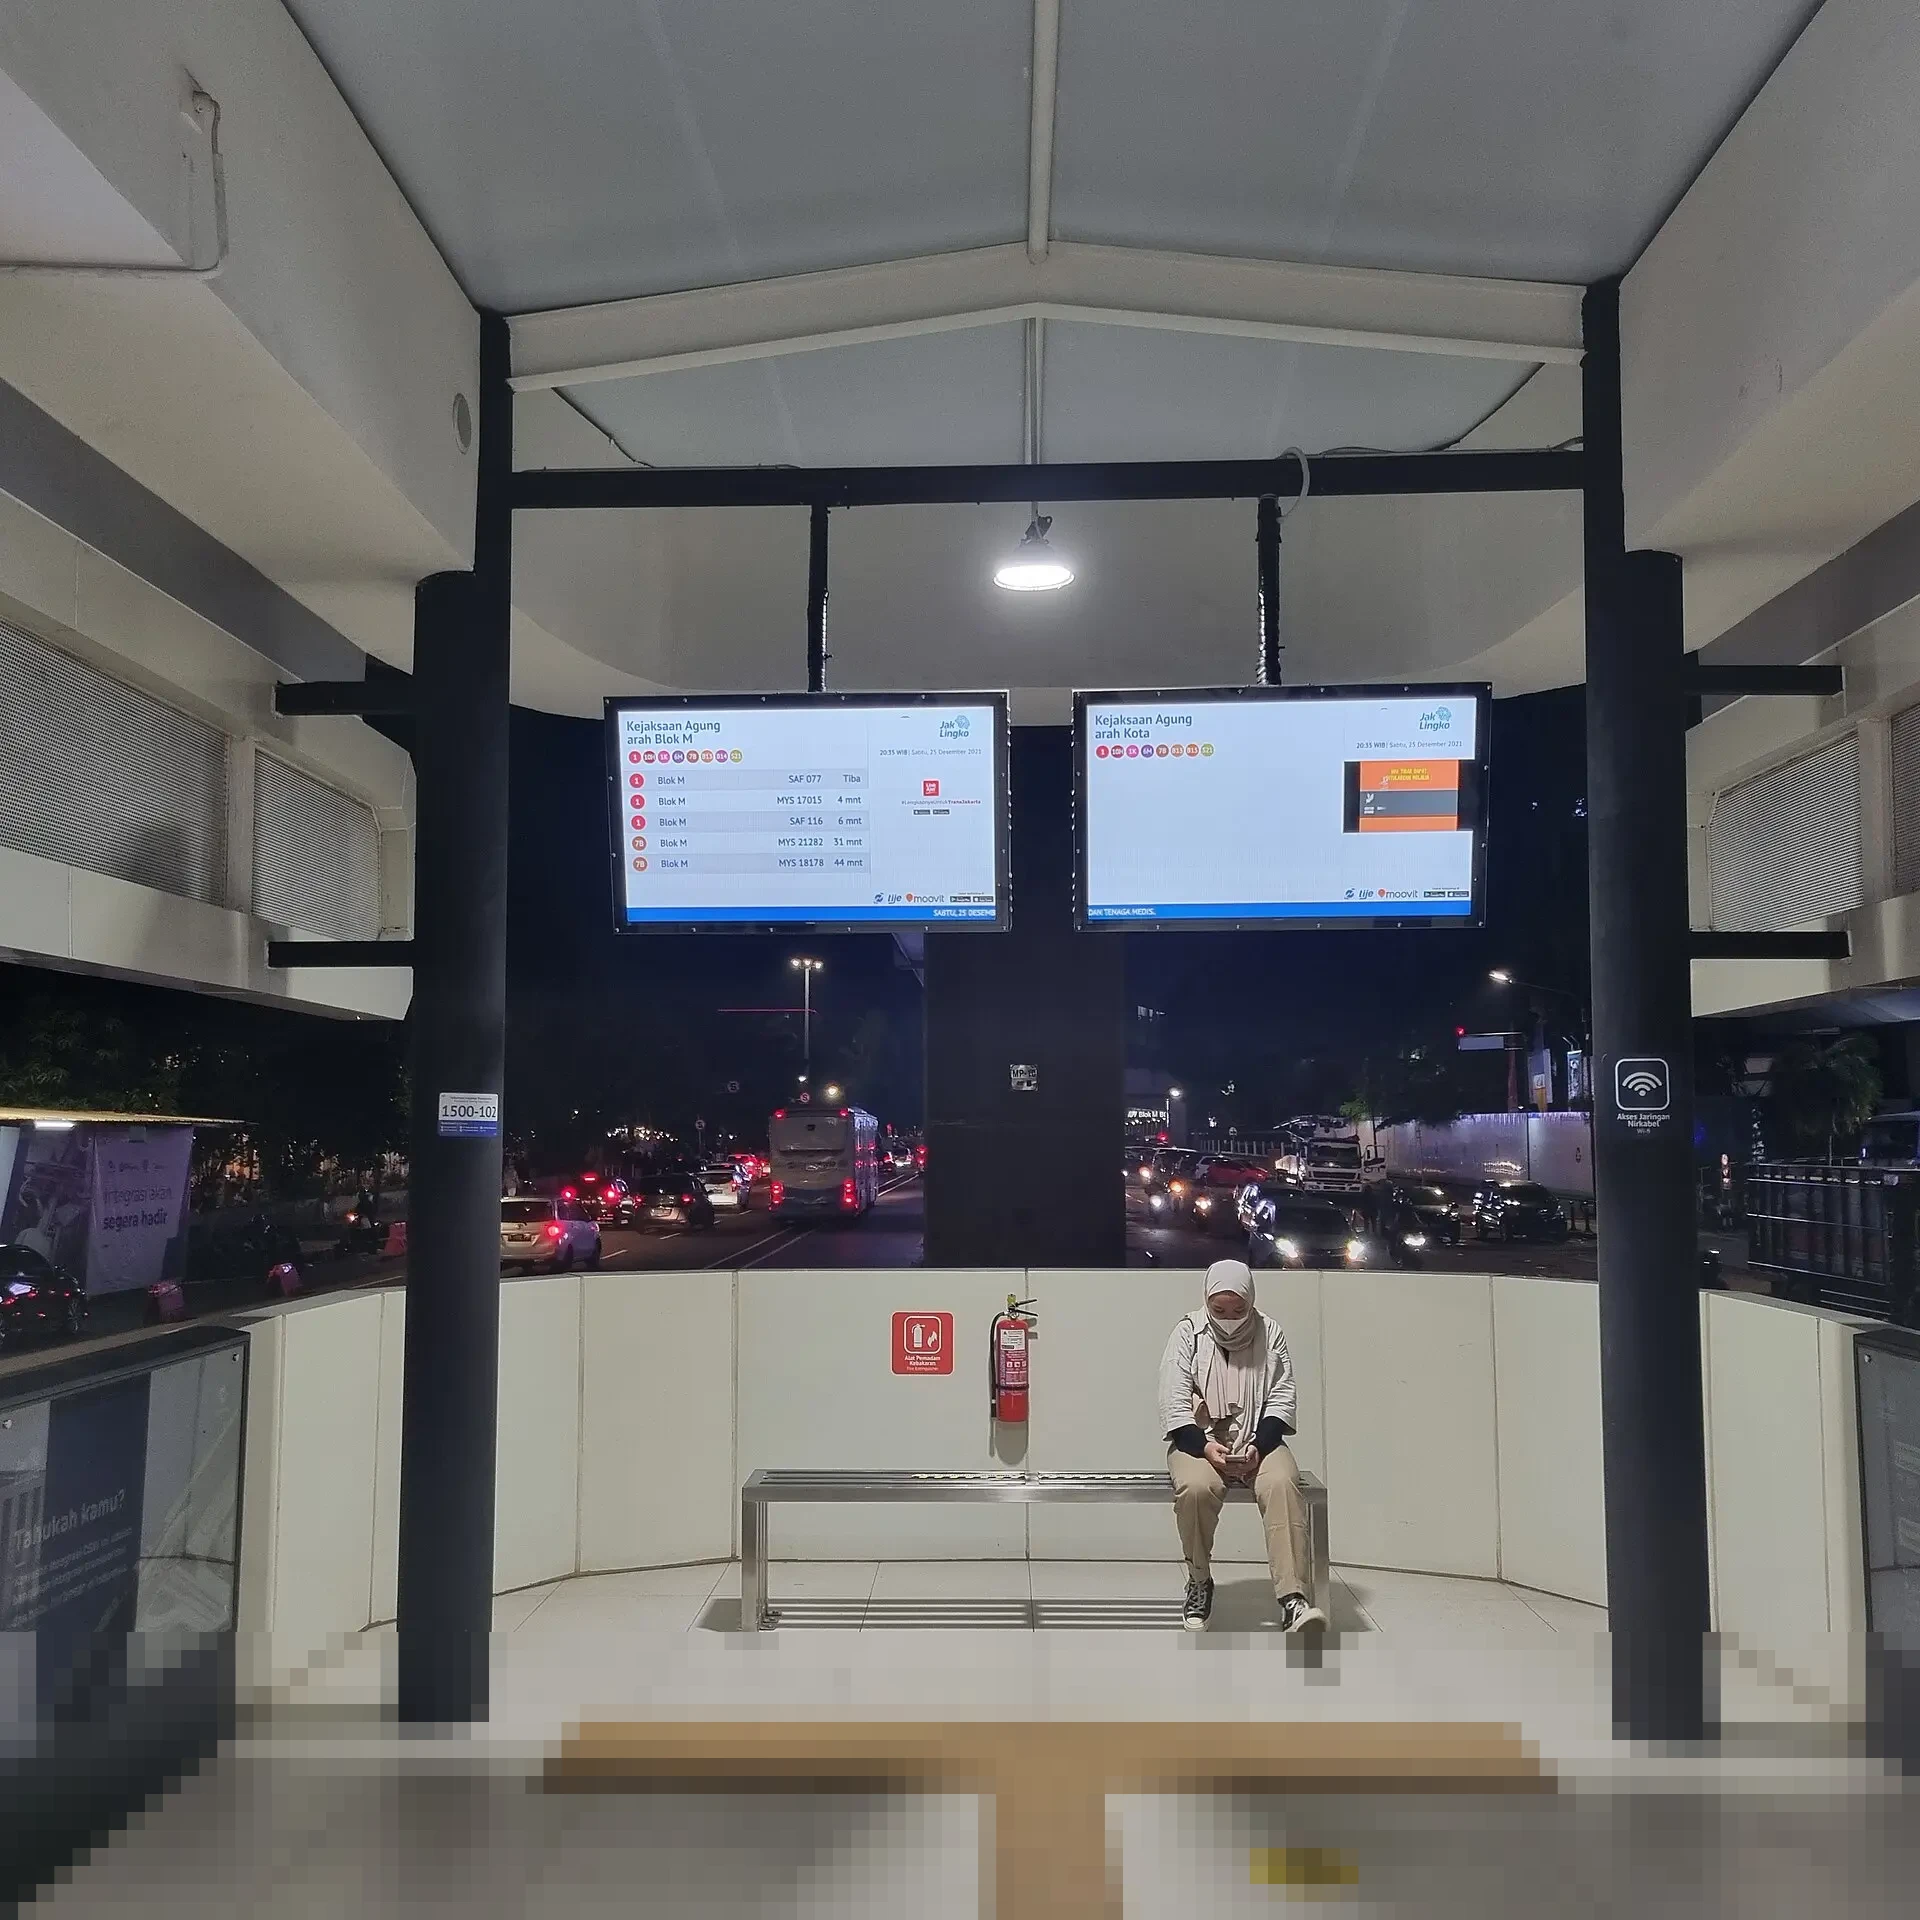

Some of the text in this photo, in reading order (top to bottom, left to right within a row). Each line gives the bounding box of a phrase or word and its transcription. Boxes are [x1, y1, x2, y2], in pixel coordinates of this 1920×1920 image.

[1095, 714, 1192, 728] Kejaksaan Agung
[1420, 713, 1436, 721] Jak
[626, 720, 721, 734] Kejaksaan Agung
[940, 721, 955, 730] Jak
[1419, 722, 1450, 732] Lingko
[939, 729, 969, 740] Lingko
[1095, 728, 1150, 739] arah Kota
[627, 734, 693, 744] arah Blok M
[788, 775, 804, 783] SAF
[806, 775, 822, 783] 077
[843, 774, 861, 782] Tiba
[777, 796, 794, 804] MYS
[797, 796, 822, 804] 17015
[837, 796, 843, 804] 4
[846, 796, 862, 804] mnt
[660, 818, 677, 826] Blok
[790, 817, 805, 825] SAF
[808, 817, 823, 825] 116
[846, 817, 862, 825] mnt
[660, 839, 678, 847] Blok
[778, 838, 796, 846] MYS
[798, 838, 823, 846] 21282
[834, 838, 843, 846] 31
[661, 860, 679, 868] Blok
[681, 860, 688, 868] M
[779, 859, 796, 867] MYS
[799, 859, 824, 867] 18178
[913, 894, 944, 903] moovit
[1385, 890, 1418, 898] moovit
[1104, 908, 1130, 916] TENAGA
[442, 1105, 496, 1118] 1500-102
[1639, 1113, 1670, 1121] Jaringan
[103, 1207, 167, 1232] segera hadir
[81, 1488, 125, 1525] kamu?
